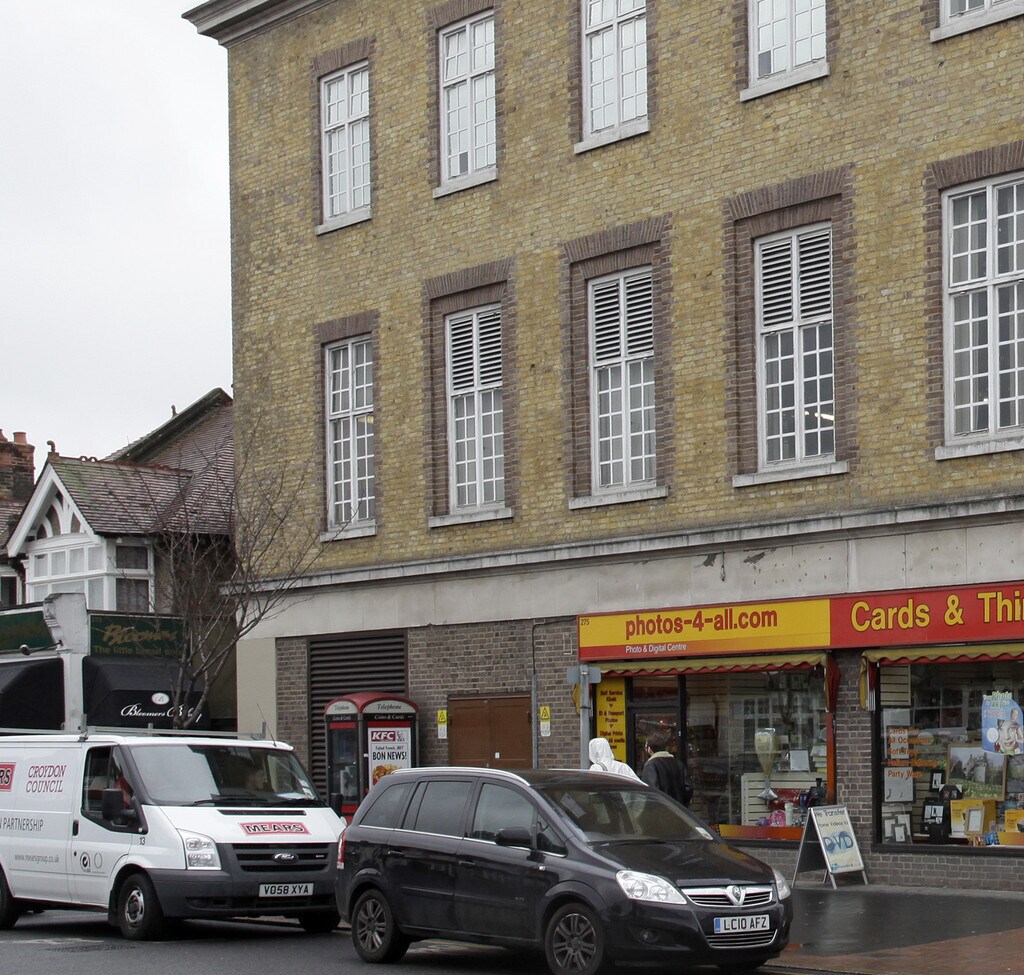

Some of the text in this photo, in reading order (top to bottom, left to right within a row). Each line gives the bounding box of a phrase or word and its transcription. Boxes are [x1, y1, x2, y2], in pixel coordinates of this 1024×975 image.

[851, 599, 930, 632] Cards
[944, 594, 964, 626] &
[580, 618, 590, 626] 275
[625, 608, 778, 640] photos-4-all.com
[94, 646, 112, 655] The
[625, 642, 687, 654] Photo & Digital Centre
[120, 702, 166, 717] Bloomers
[371, 731, 394, 740] KFC
[372, 751, 407, 760] BON NEWS!
[28, 765, 67, 778] CROYDON
[888, 770, 904, 778] Party
[26, 780, 63, 793] COUNCIL
[823, 808, 846, 817] Transfer
[2, 817, 44, 831] PARTNERSHIP
[245, 823, 304, 833] MEARS
[140, 836, 146, 845] 13
[823, 833, 854, 851] DVD
[264, 885, 309, 895] VO58 XYA
[723, 916, 767, 931] LC10 AFZ
